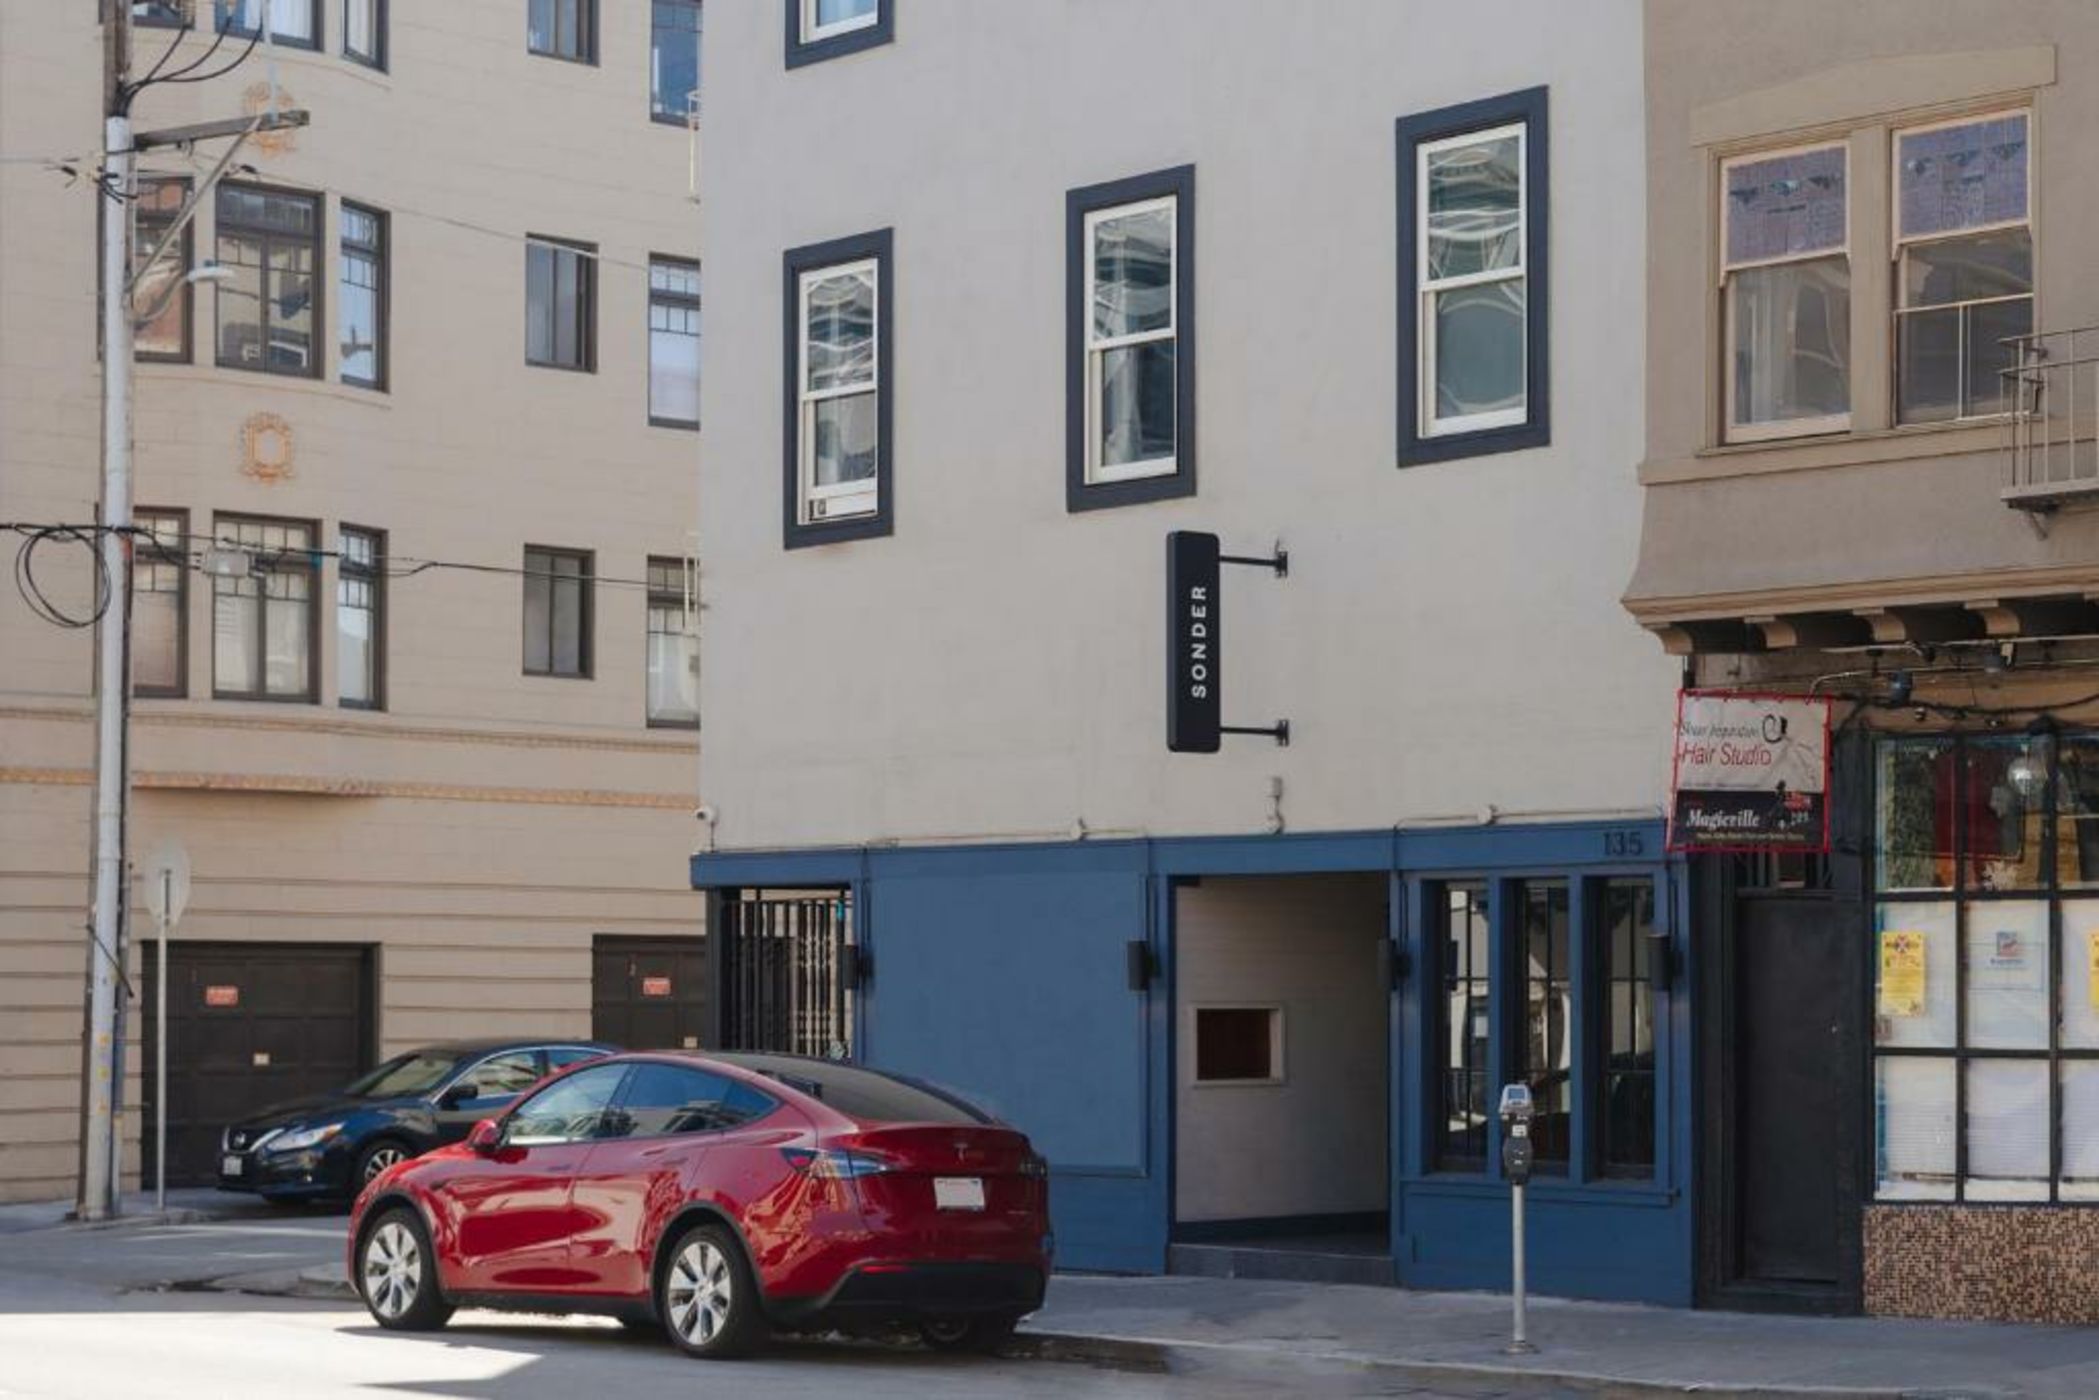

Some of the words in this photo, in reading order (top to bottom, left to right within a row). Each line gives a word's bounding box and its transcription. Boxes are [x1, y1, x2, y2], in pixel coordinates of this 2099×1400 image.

[1191, 586, 1208, 699] SONDER
[1681, 742, 1715, 764] Hair
[1720, 742, 1772, 766] Studio
[1686, 808, 1760, 830] Magicville
[1603, 831, 1643, 856] 135
